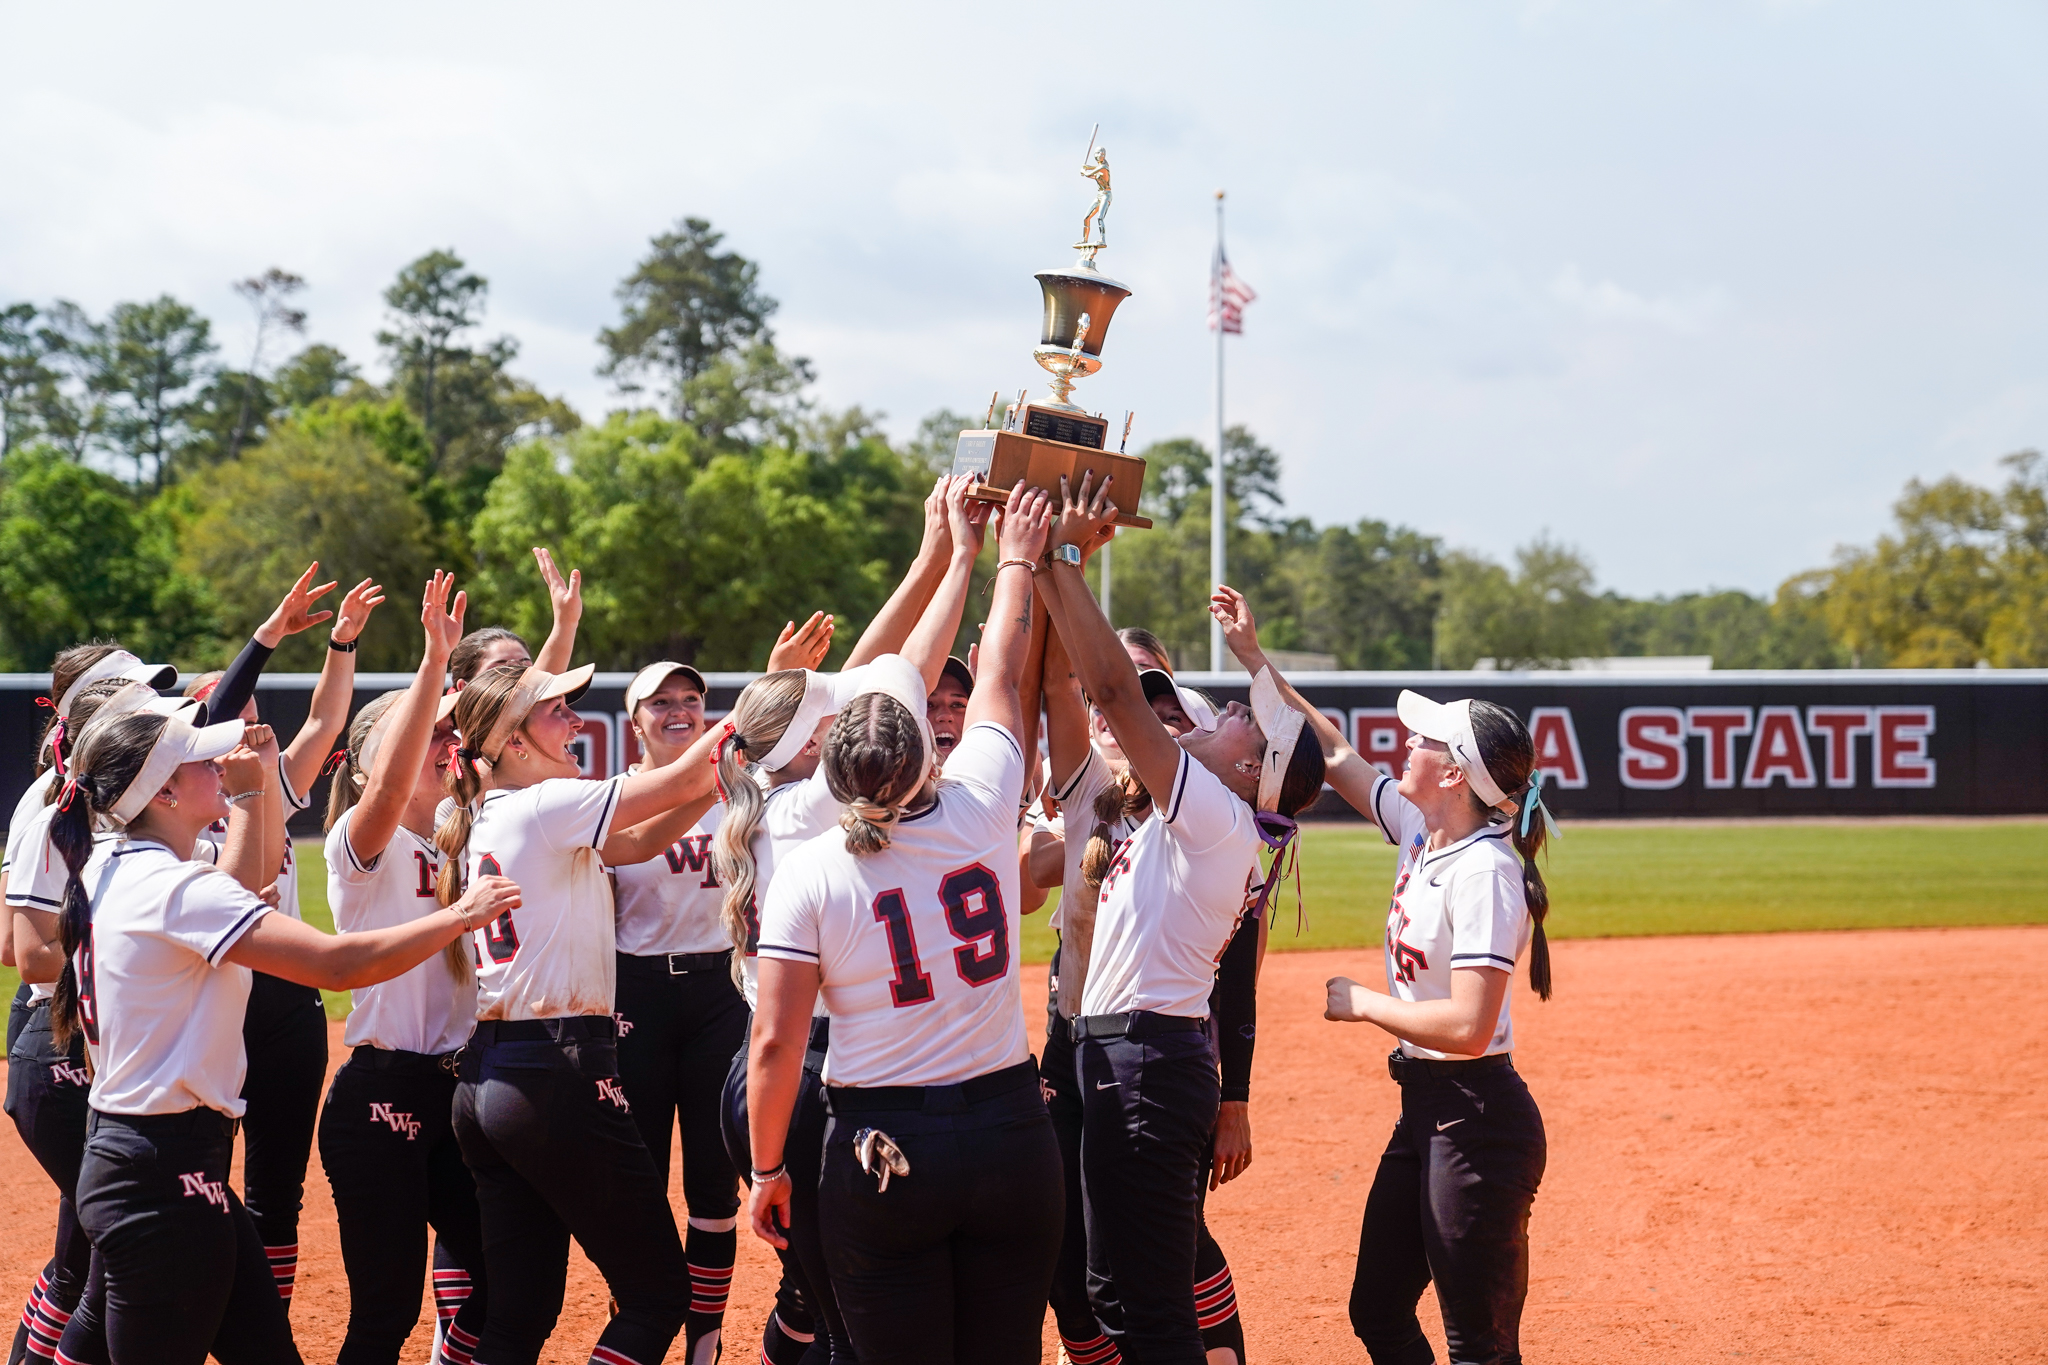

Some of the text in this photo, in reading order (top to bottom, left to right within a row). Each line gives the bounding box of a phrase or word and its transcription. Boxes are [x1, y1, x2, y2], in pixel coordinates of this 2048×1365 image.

[1618, 705, 1936, 790] STATE
[872, 862, 1010, 1008] 19
[368, 1102, 423, 1141] NWF
